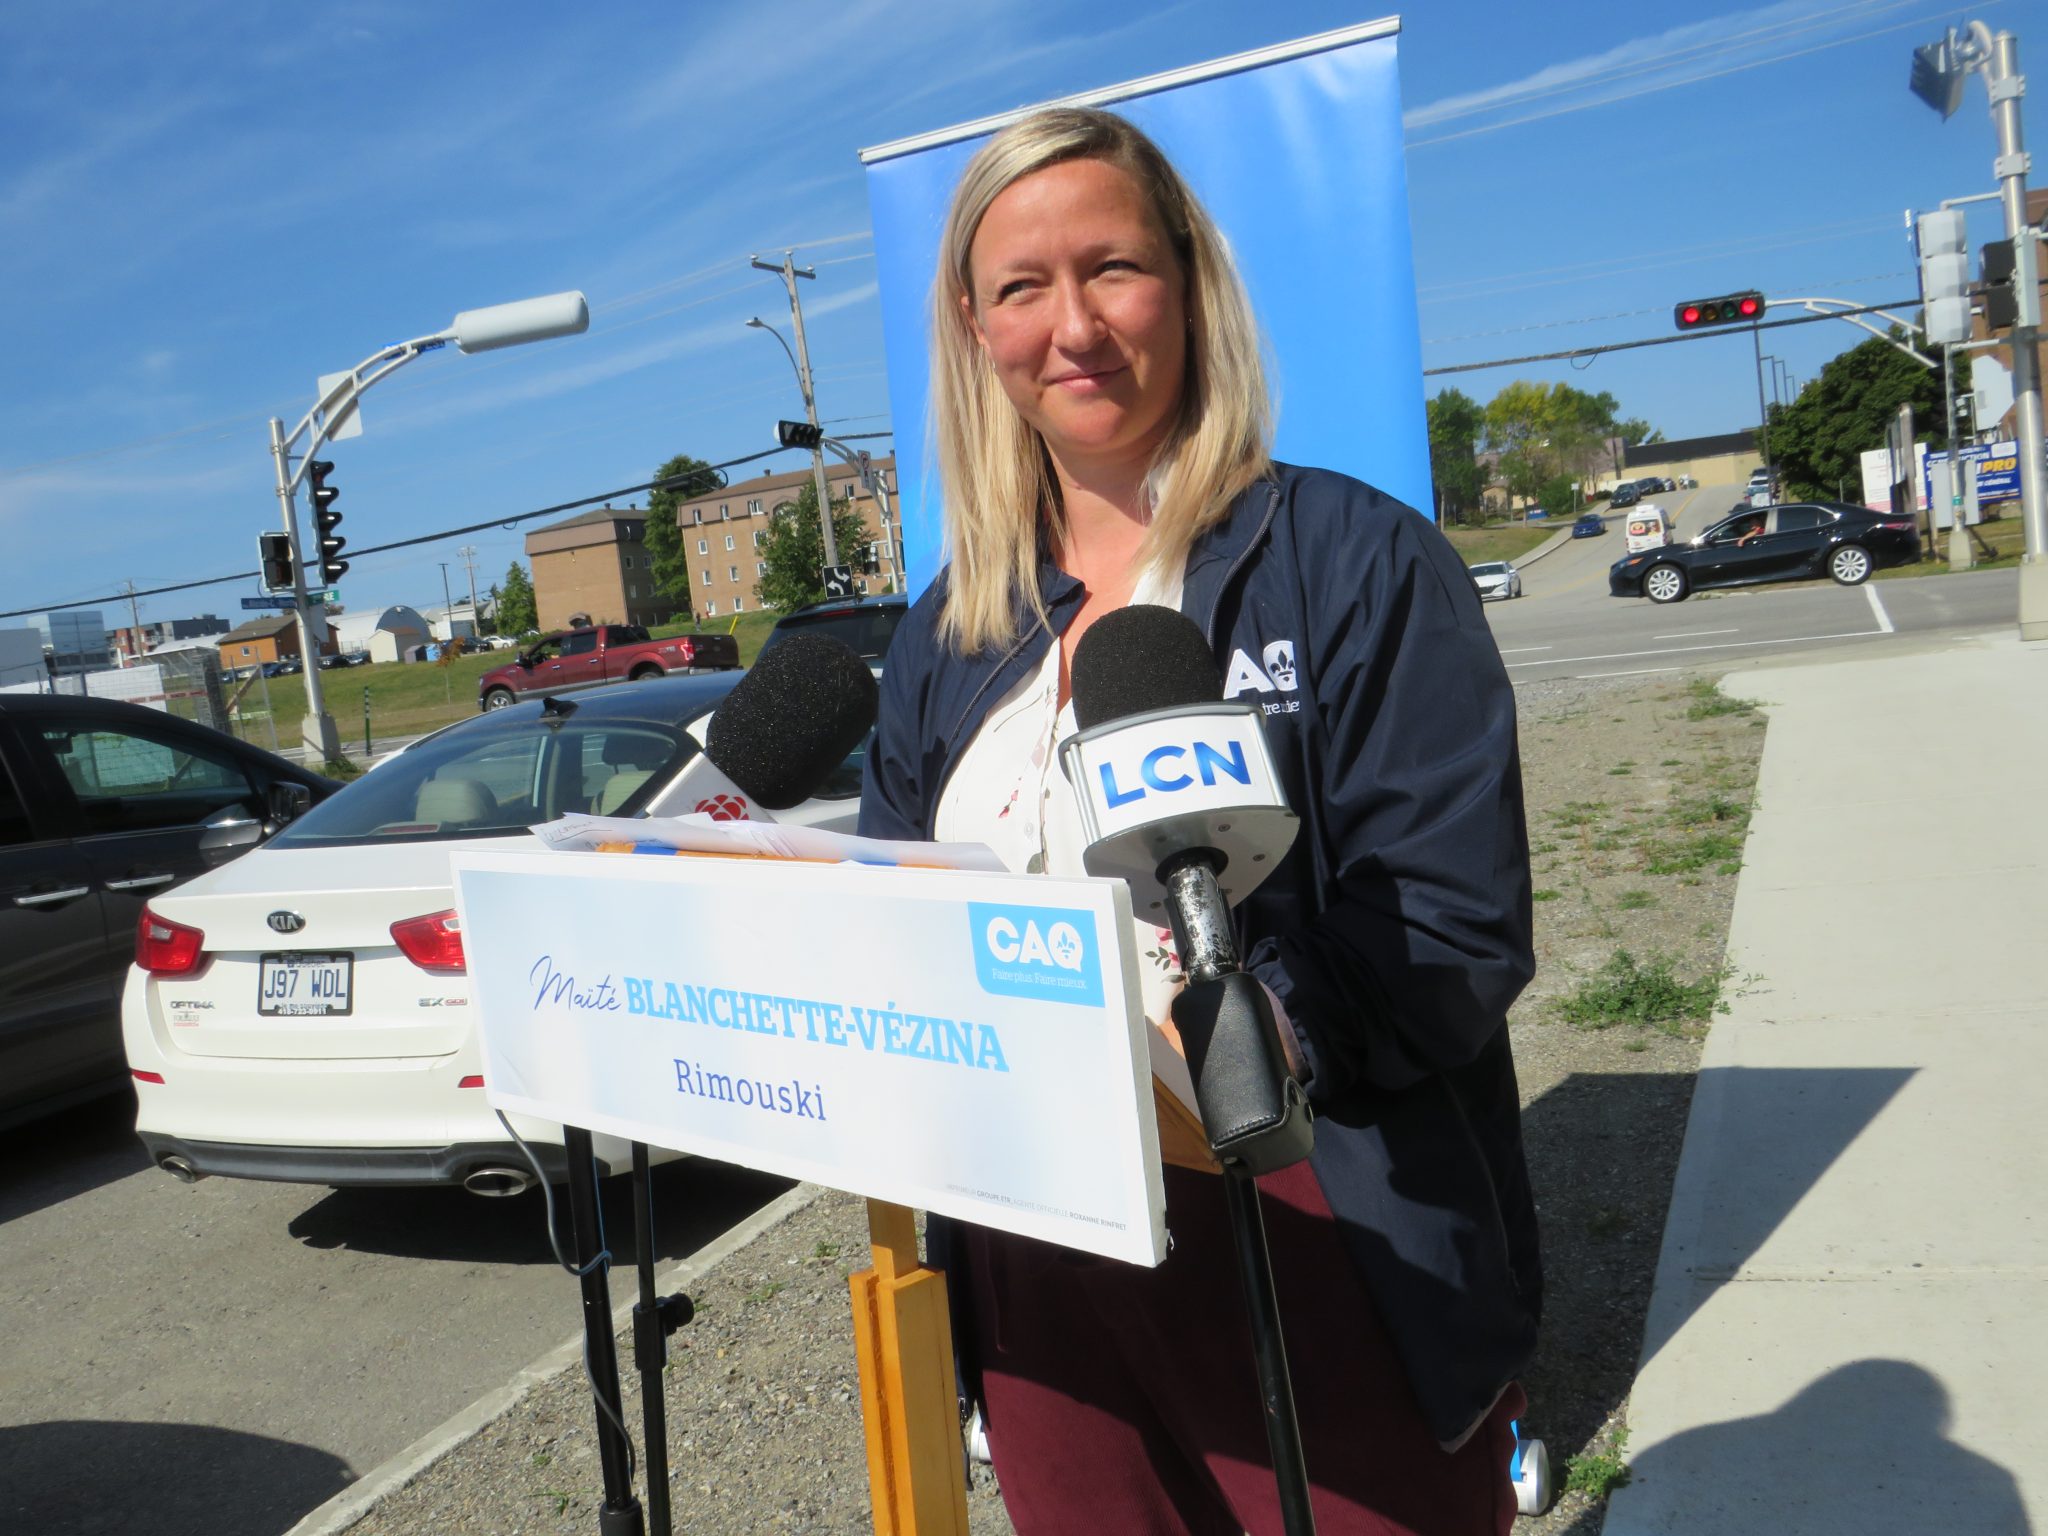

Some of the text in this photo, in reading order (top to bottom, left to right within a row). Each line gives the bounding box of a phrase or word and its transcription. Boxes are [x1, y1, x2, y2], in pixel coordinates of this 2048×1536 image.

[1223, 640, 1298, 700] AQ
[1099, 741, 1252, 809] LCN
[270, 915, 299, 930] KIA
[987, 916, 1083, 973] CAQ
[264, 968, 346, 998] J97 WDL
[992, 968, 1013, 981] Faire
[1034, 973, 1057, 985] Faire
[529, 955, 1009, 1073] Maïté BLANCHETTE-VÉZINA
[673, 1058, 827, 1122] Rimouski
[977, 1190, 1000, 1202] GROUPE
[1069, 1211, 1100, 1225] ROXANNE
[1100, 1219, 1127, 1231] RINFRET
